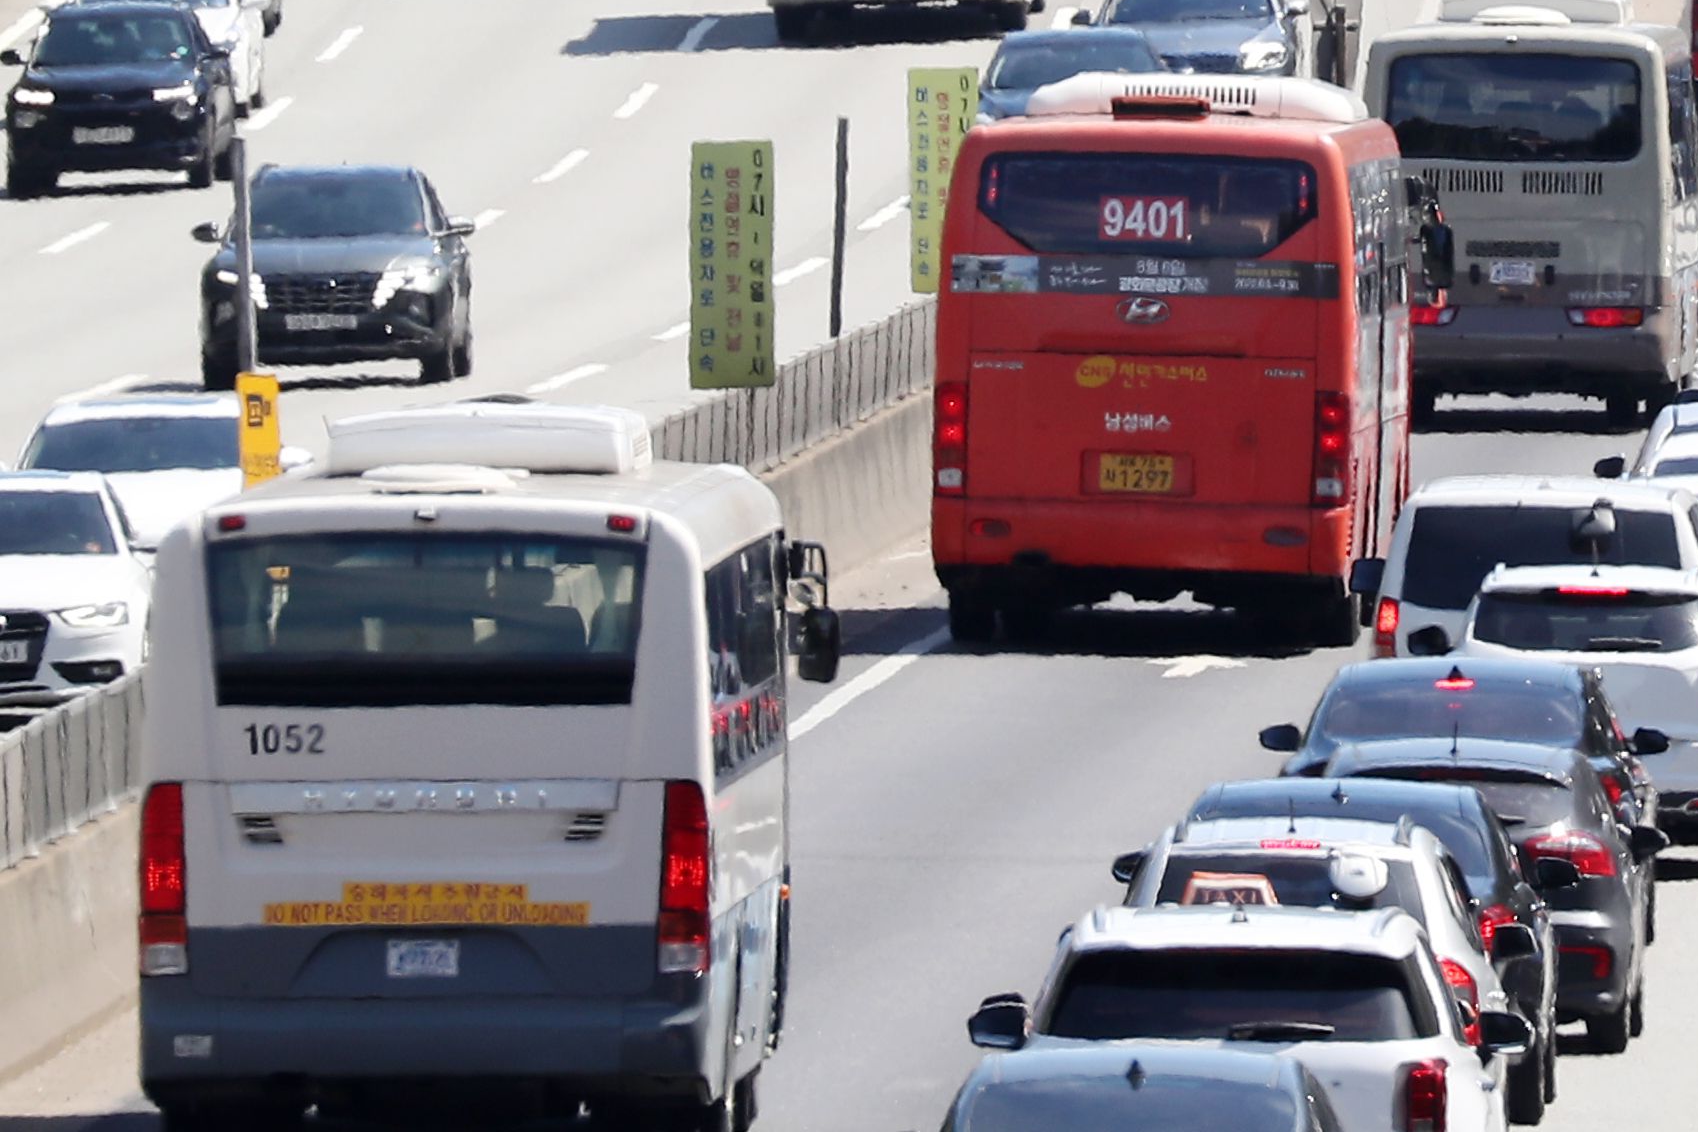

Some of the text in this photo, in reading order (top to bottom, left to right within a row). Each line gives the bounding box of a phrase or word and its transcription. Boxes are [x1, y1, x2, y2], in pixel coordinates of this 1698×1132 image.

[748, 149, 765, 217] 07시
[1104, 200, 1186, 238] 9401
[1104, 412, 1172, 433] 남성버스
[1119, 469, 1169, 489] 1297
[244, 723, 325, 755] 1052
[1202, 889, 1257, 905] TAXI
[292, 905, 320, 924] NOT
[325, 905, 363, 923] PASS
[503, 904, 586, 923] UNLOADING
